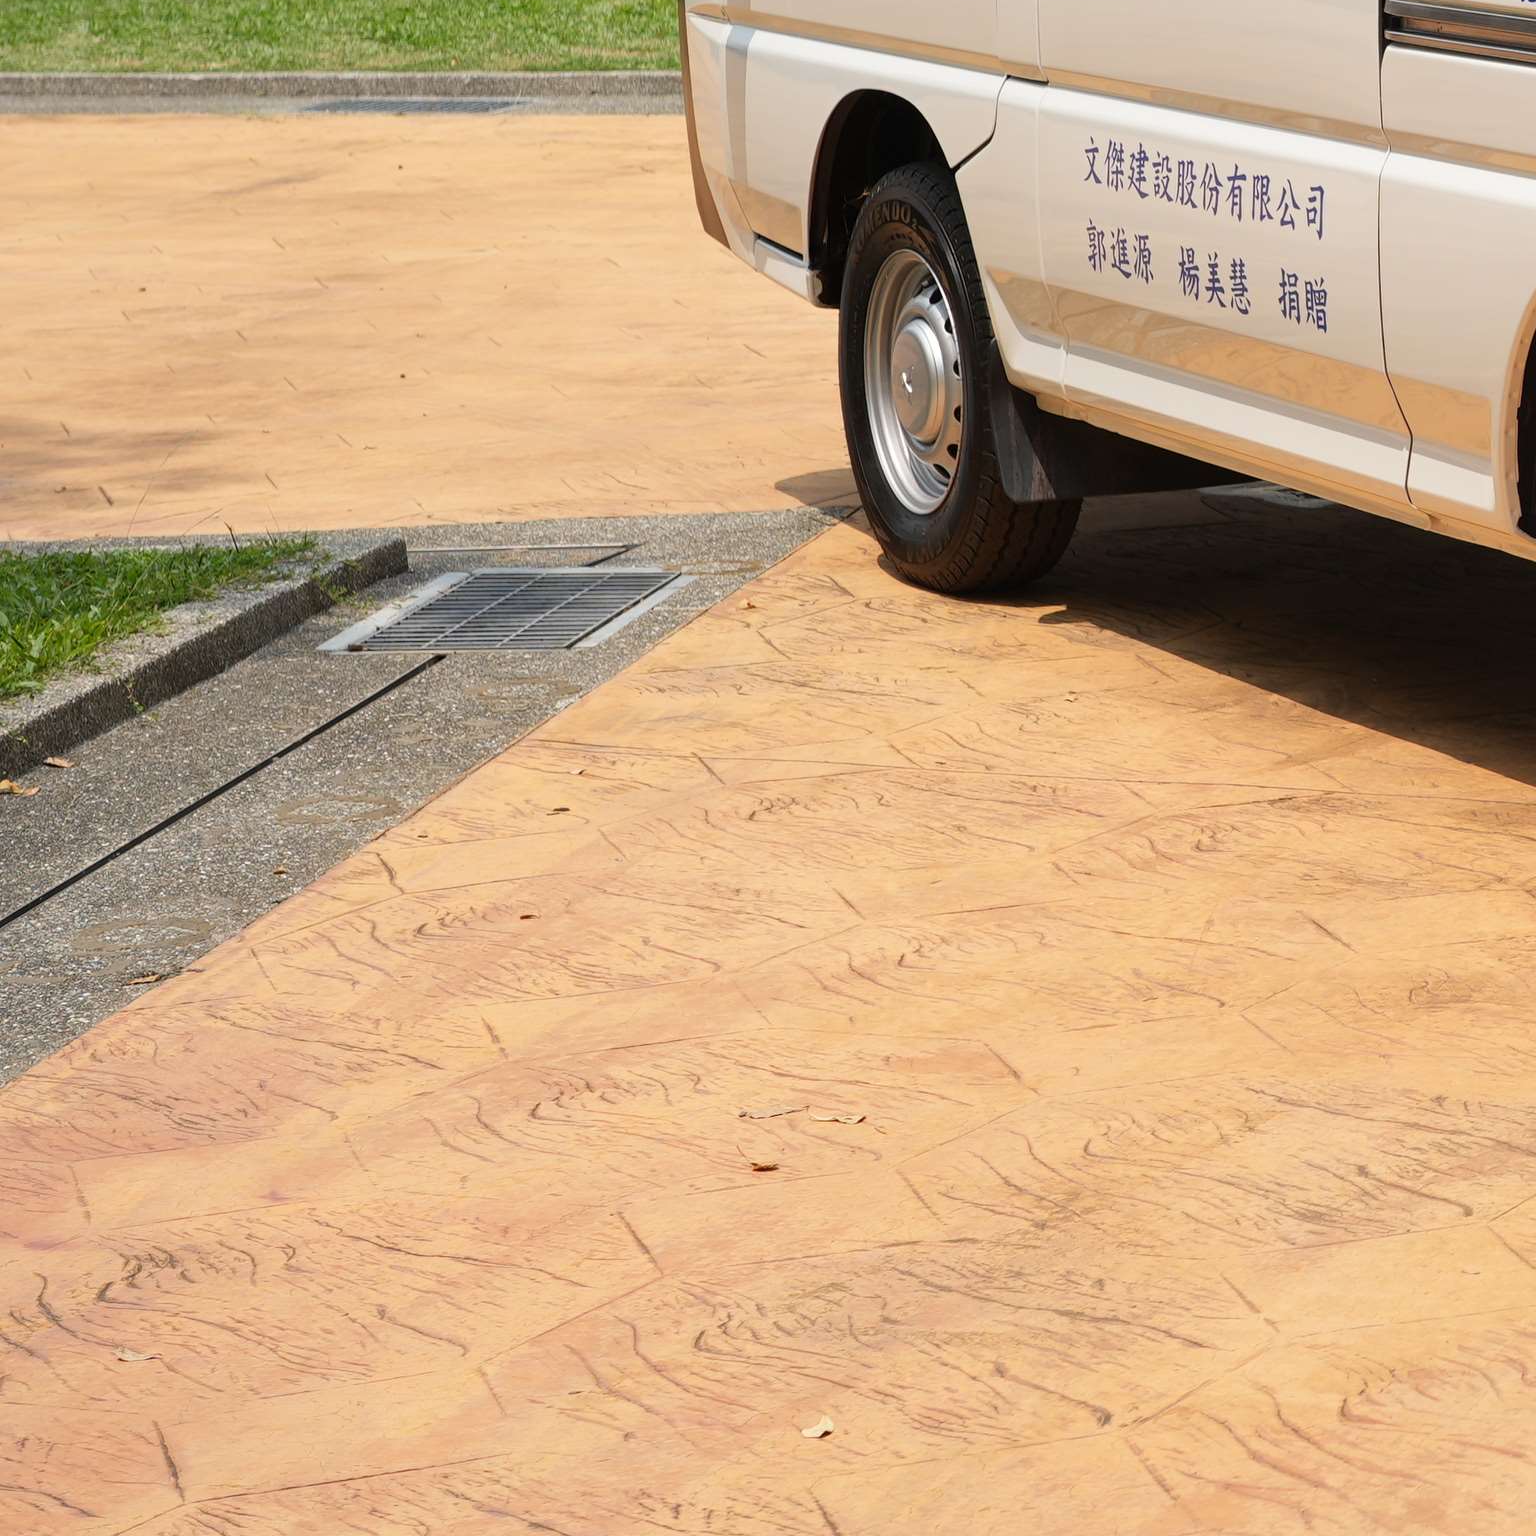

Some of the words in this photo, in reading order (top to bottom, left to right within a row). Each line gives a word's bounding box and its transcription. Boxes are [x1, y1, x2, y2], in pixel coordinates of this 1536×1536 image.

[1084, 135, 1326, 241] 文傑建設股份有限公司
[1086, 217, 1154, 286] 郭進源
[1178, 245, 1251, 316] 楊美慧
[1278, 267, 1329, 335] 捐贈
